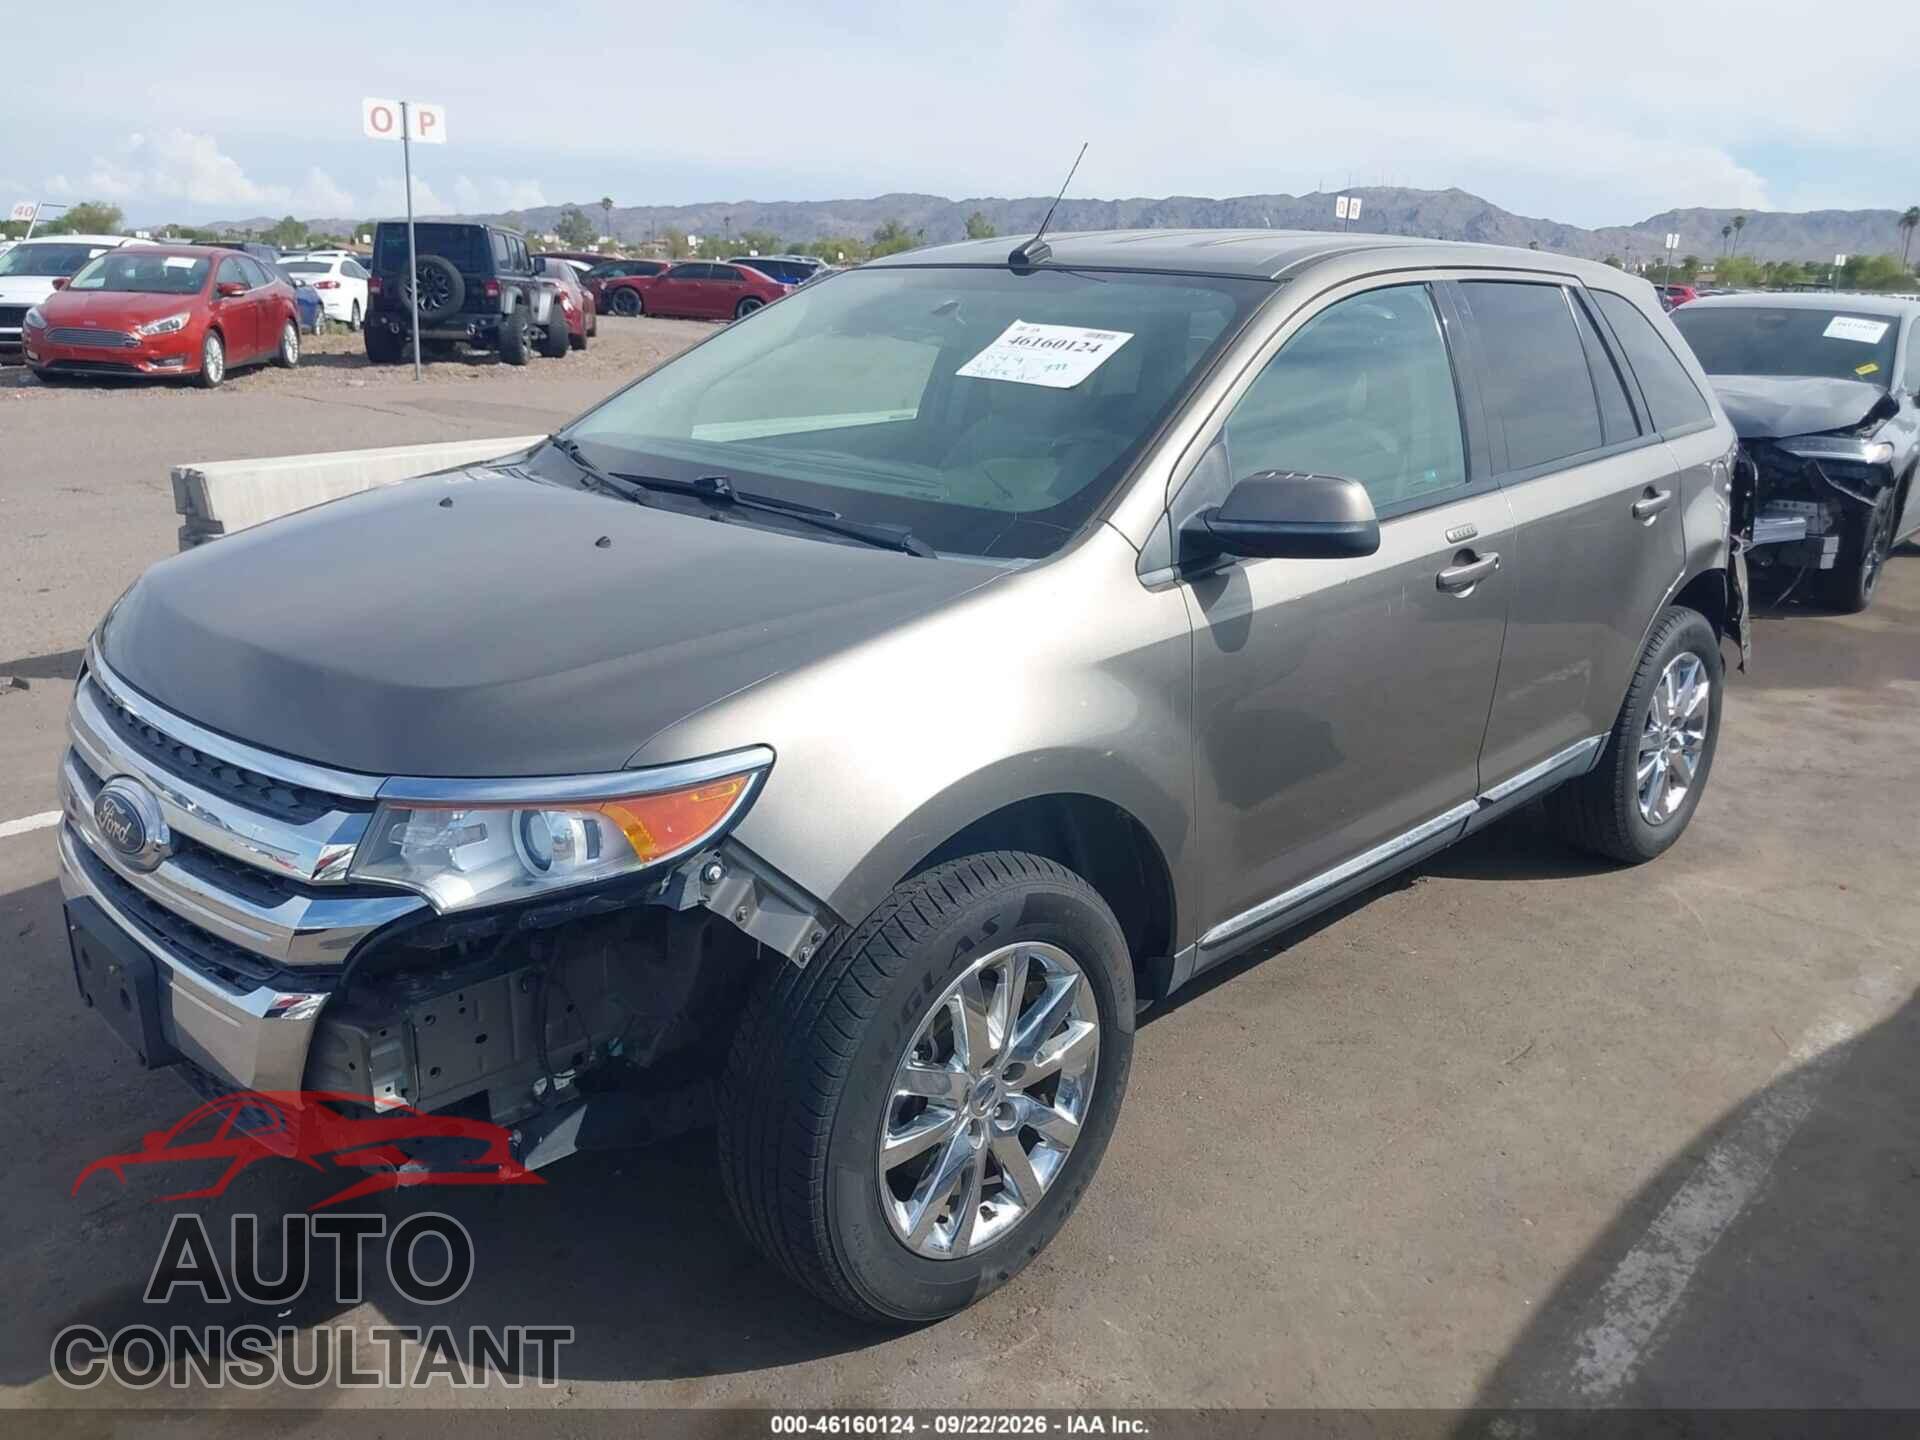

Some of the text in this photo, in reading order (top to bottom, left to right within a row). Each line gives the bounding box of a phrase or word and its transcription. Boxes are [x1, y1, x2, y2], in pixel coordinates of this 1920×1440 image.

[371, 106, 393, 133] O
[419, 111, 436, 137] P
[14, 205, 34, 217] 40
[1008, 335, 1103, 354] 46160124
[98, 798, 132, 845] Ford
